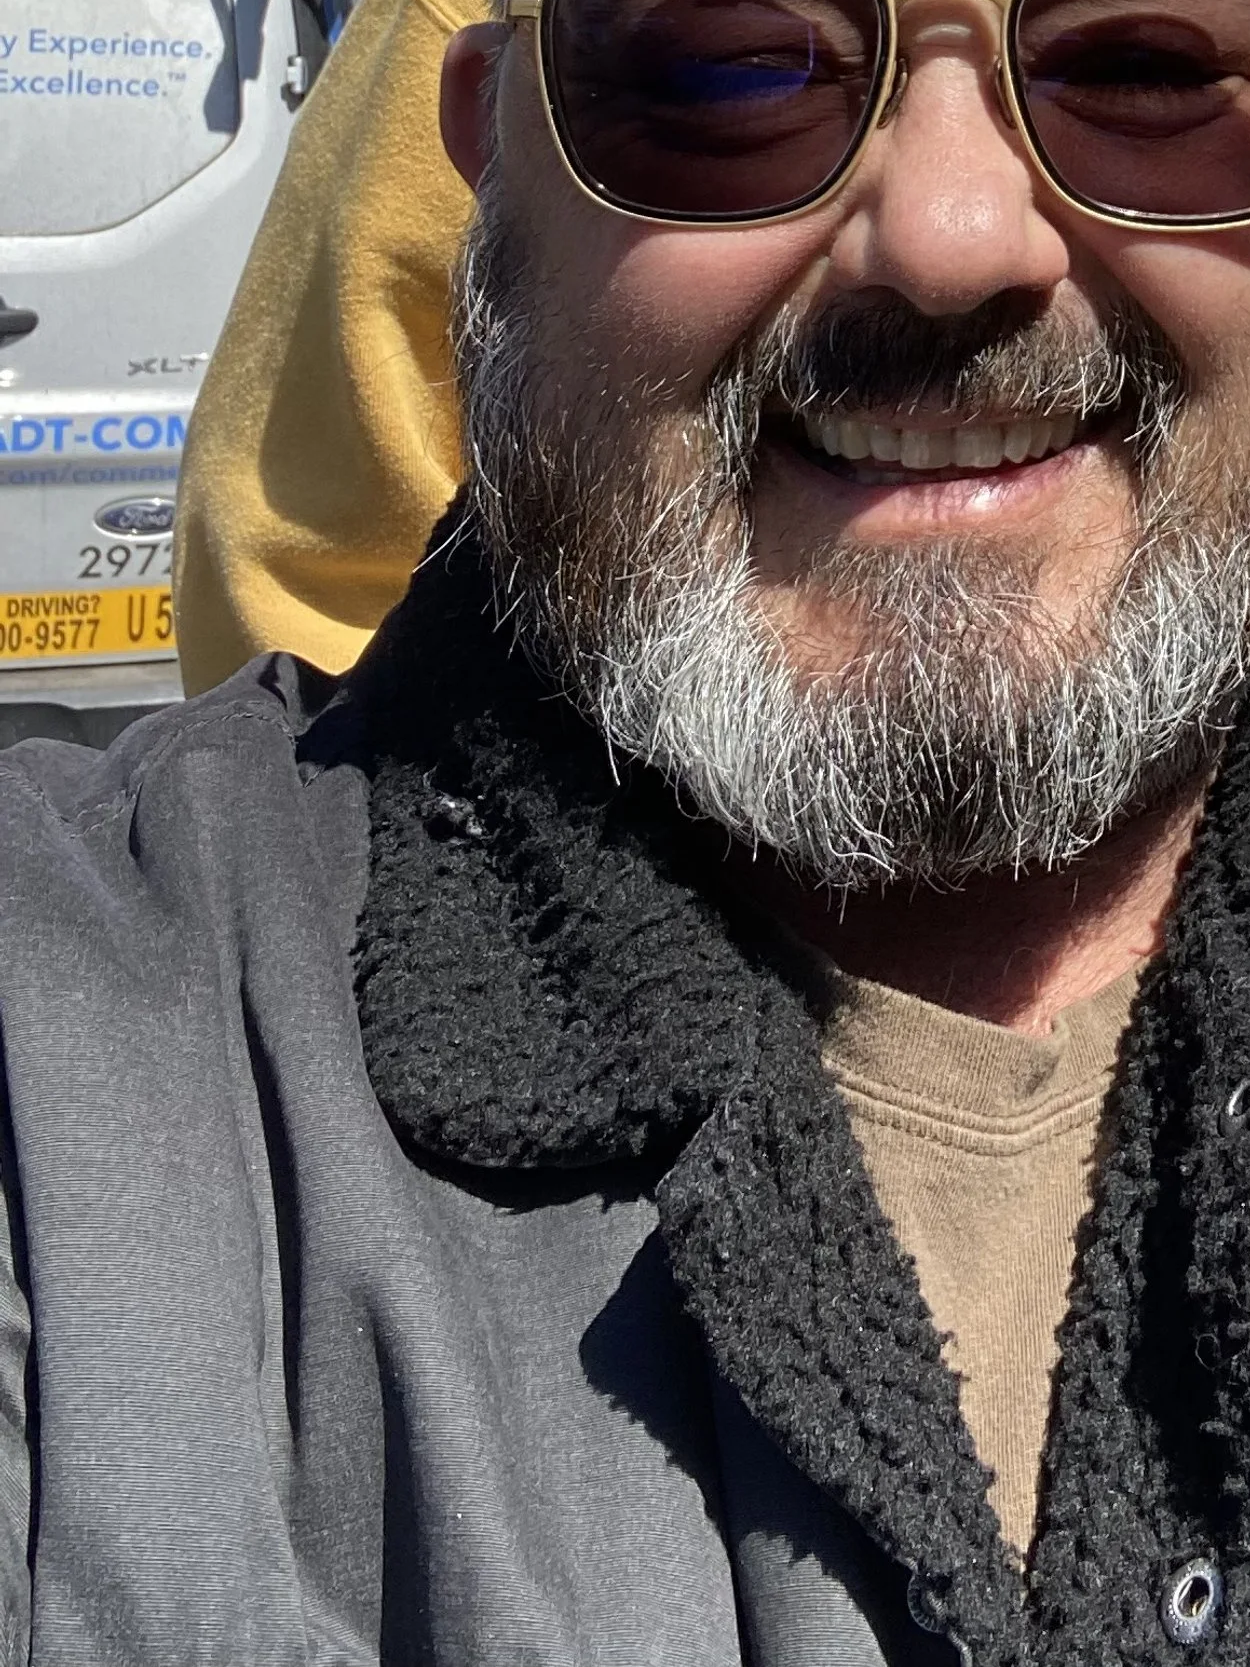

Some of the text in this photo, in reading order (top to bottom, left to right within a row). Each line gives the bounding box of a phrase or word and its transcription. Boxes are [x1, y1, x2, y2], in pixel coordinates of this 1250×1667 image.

[28, 28, 213, 62] Experience.
[127, 352, 208, 376] XLT
[0, 414, 188, 454] DT-CO
[7, 594, 101, 619] DRIVING?
